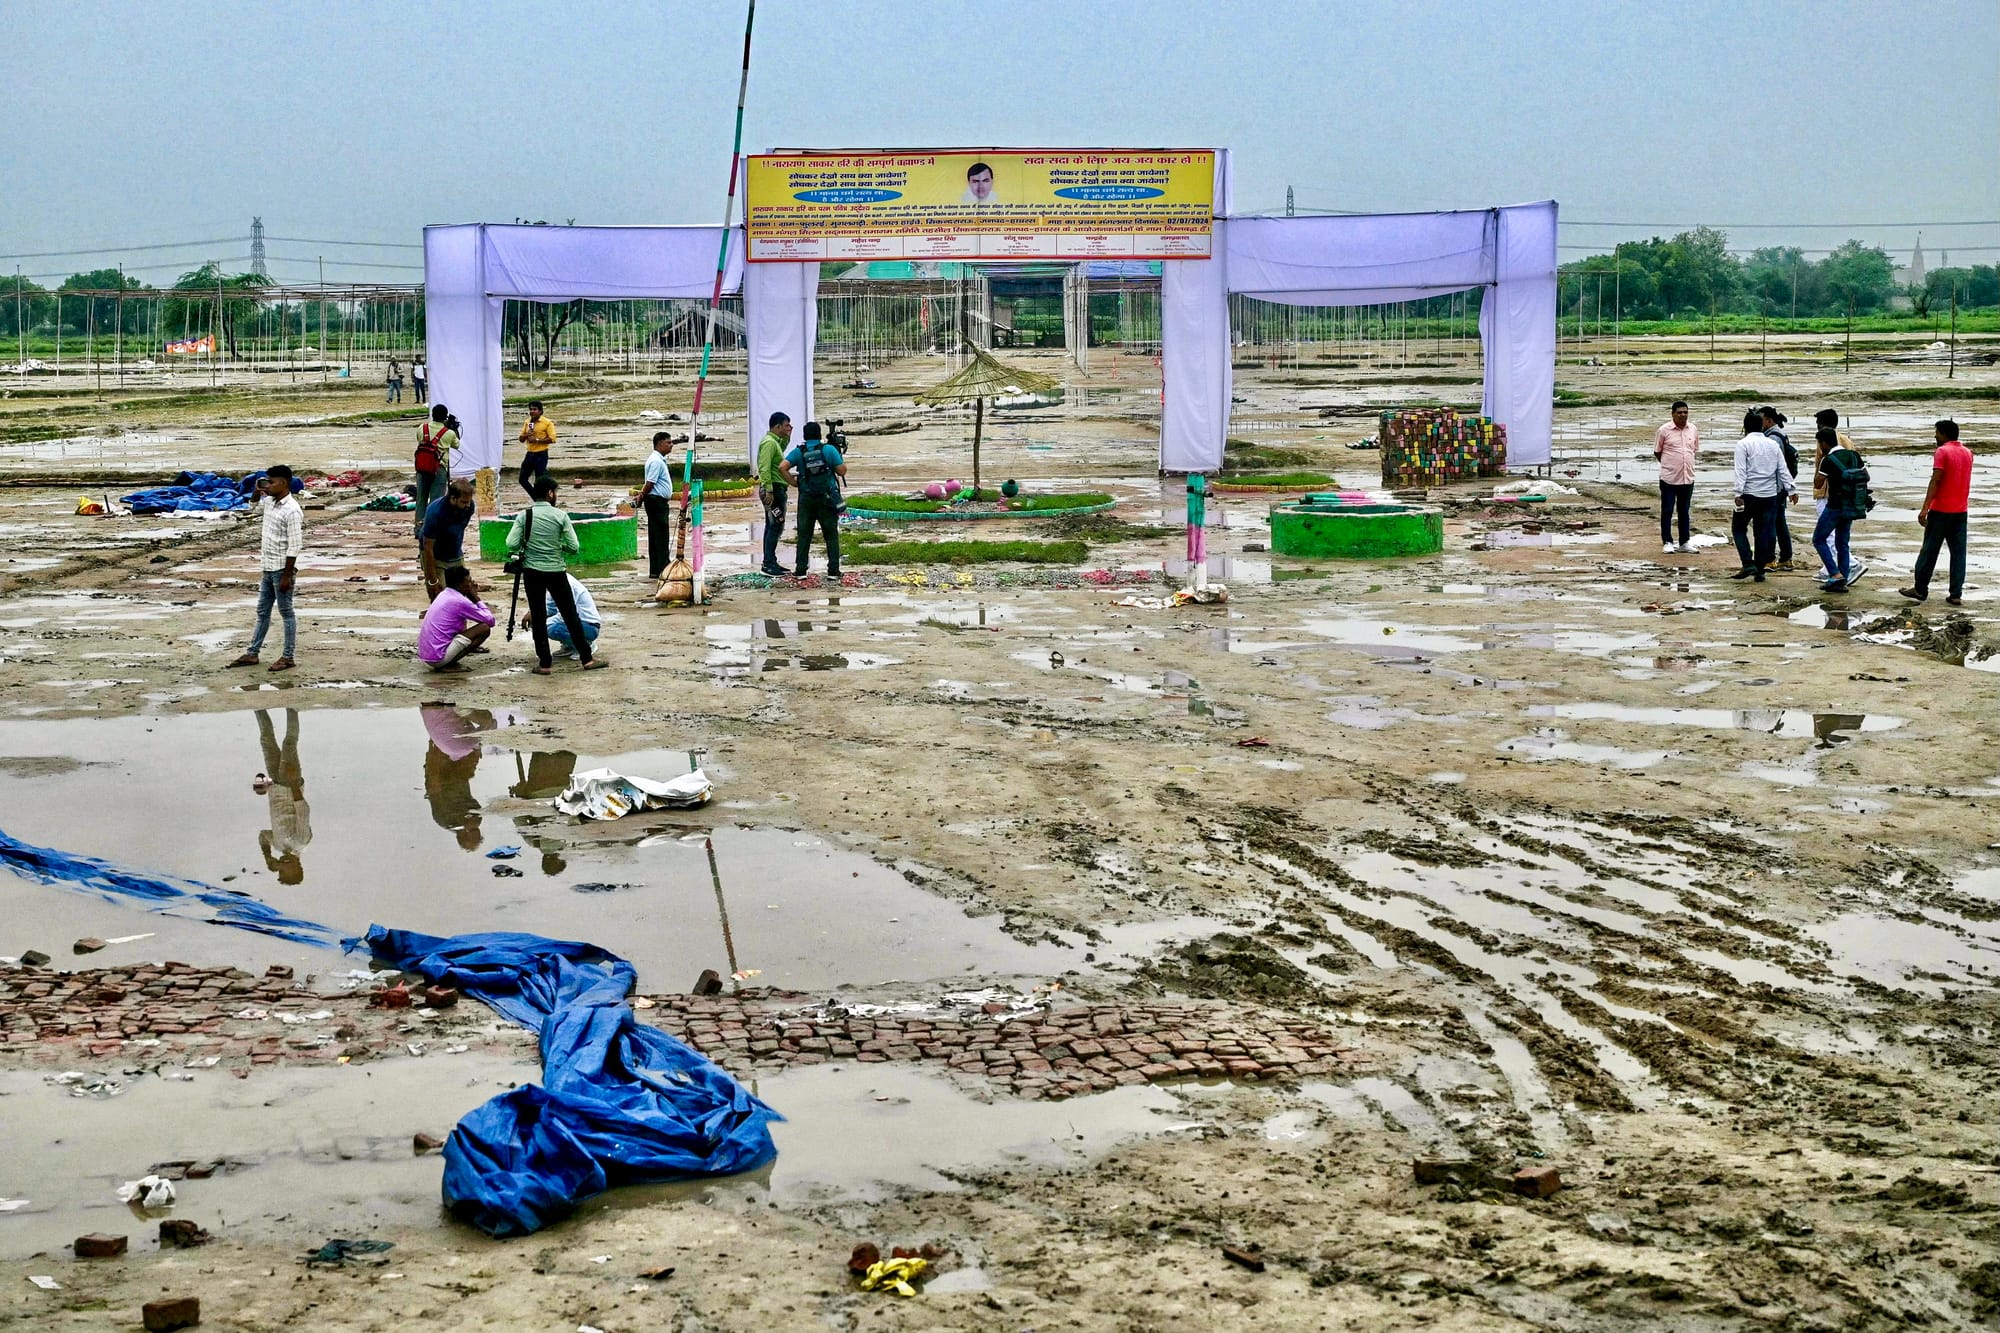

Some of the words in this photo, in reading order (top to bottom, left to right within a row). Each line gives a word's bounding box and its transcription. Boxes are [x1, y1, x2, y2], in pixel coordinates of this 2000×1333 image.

[838, 159, 850, 167] हरि
[853, 158, 864, 166] की
[1073, 156, 1083, 164] के
[1088, 156, 1108, 164] लिए
[1181, 156, 1191, 164] हो
